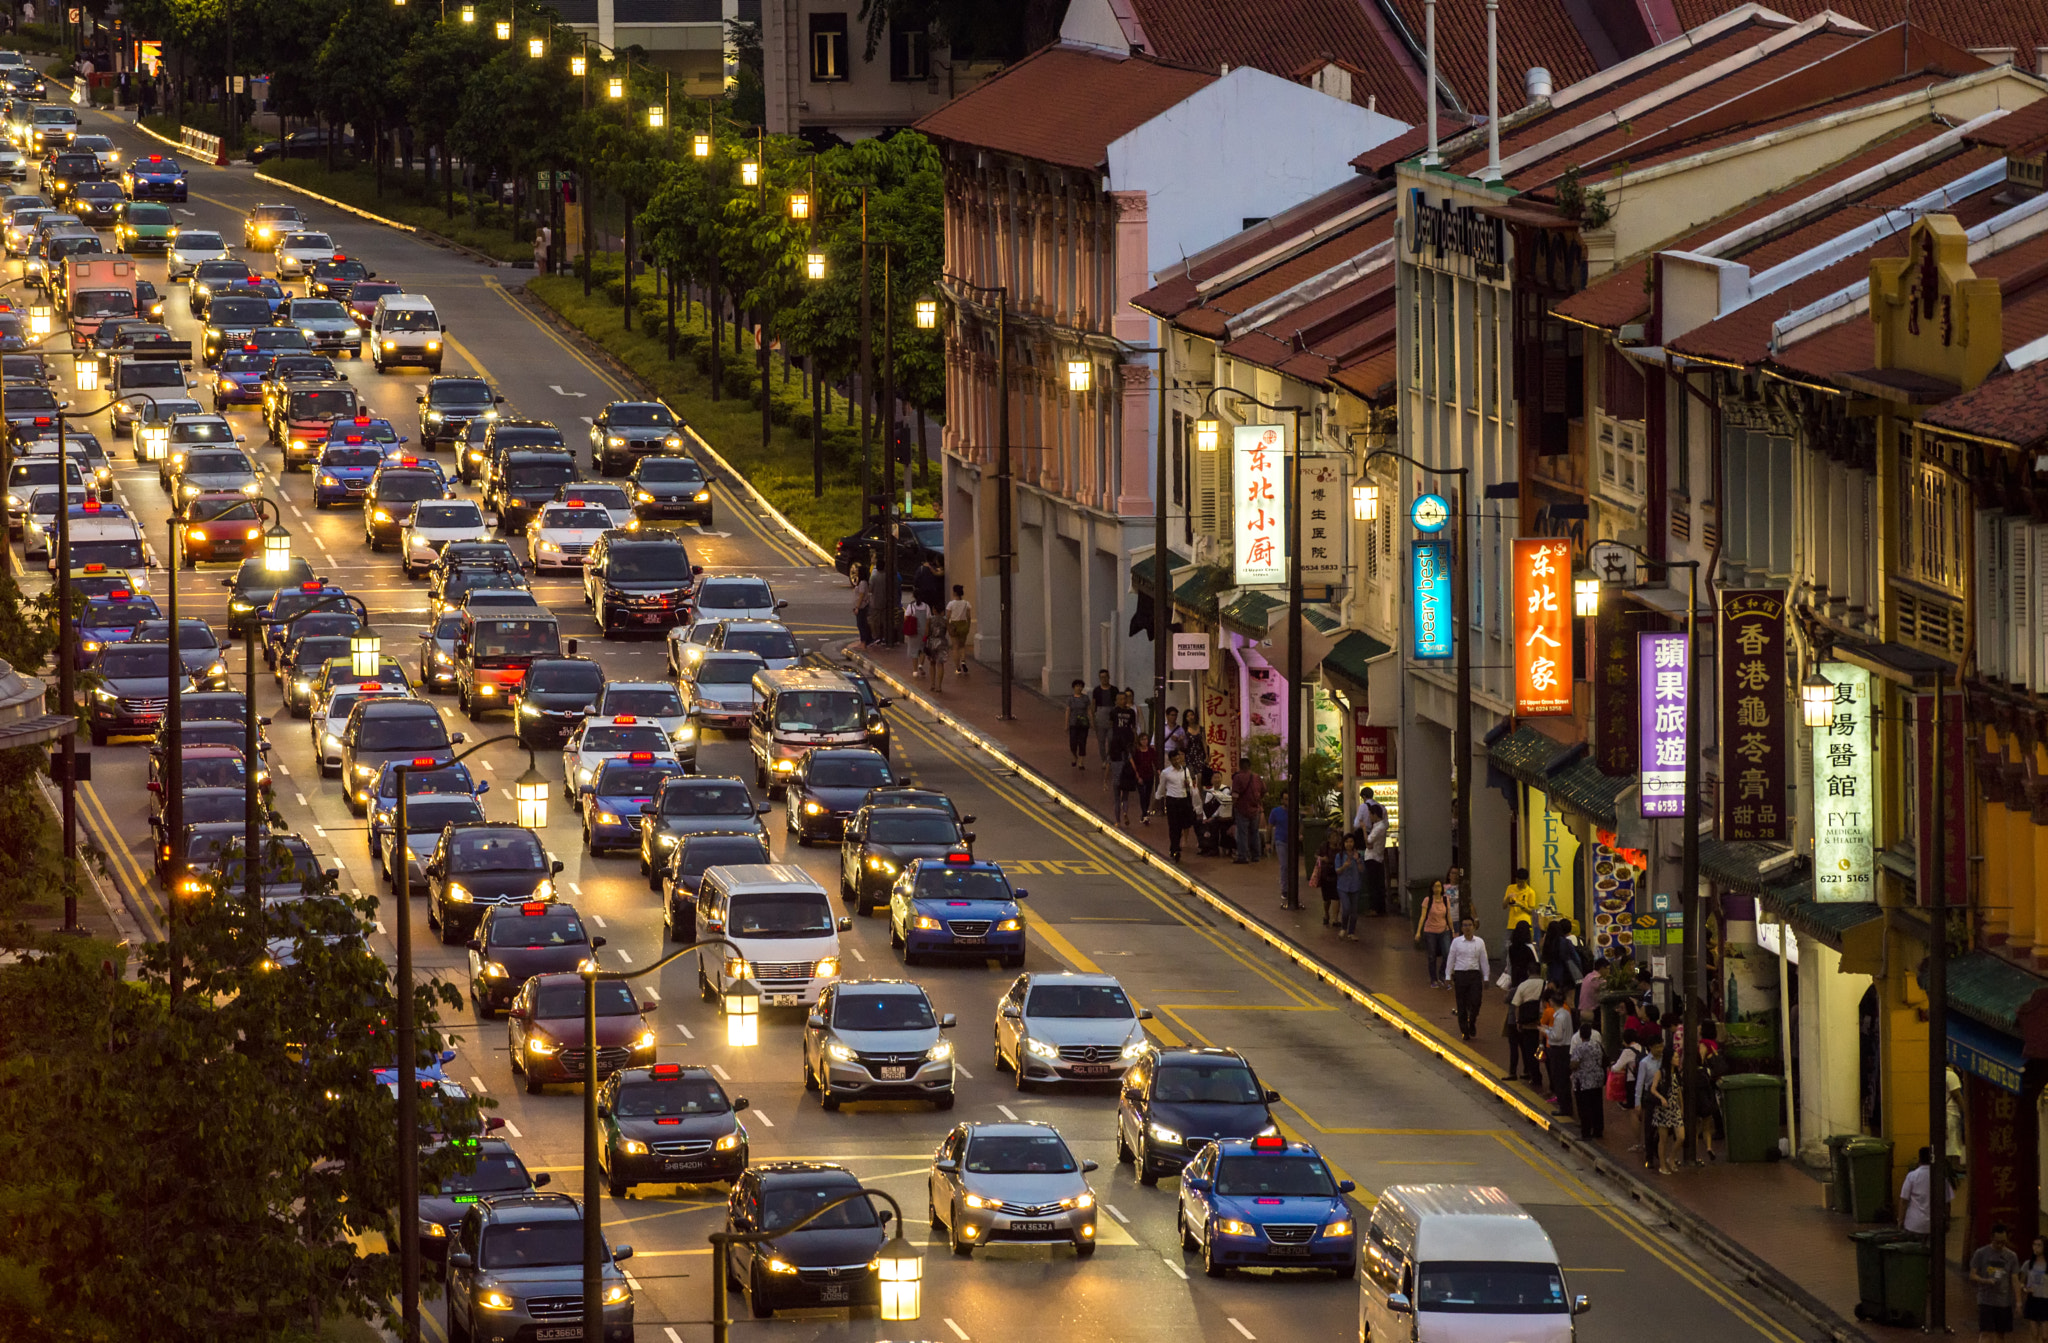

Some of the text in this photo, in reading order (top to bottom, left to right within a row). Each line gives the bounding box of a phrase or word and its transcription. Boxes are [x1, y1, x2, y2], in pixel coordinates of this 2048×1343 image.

[1417, 192, 1443, 258] beary
[1246, 441, 1275, 567] 东北小厨
[1311, 488, 1327, 559] 博生医院
[1417, 544, 1434, 590] best!
[1437, 544, 1448, 580] hostel
[1418, 593, 1439, 643] beary
[1526, 545, 1561, 691] 东北人家
[1655, 638, 1685, 767] 蘋果旅遊
[1736, 623, 1771, 799] 香港龜苓膏
[1732, 804, 1777, 824] 甜品
[1734, 828, 1775, 838] No. 28
[1828, 811, 1861, 827] FYT
[1820, 874, 1869, 883] 6221 5165
[826, 1285, 842, 1293] SGT
